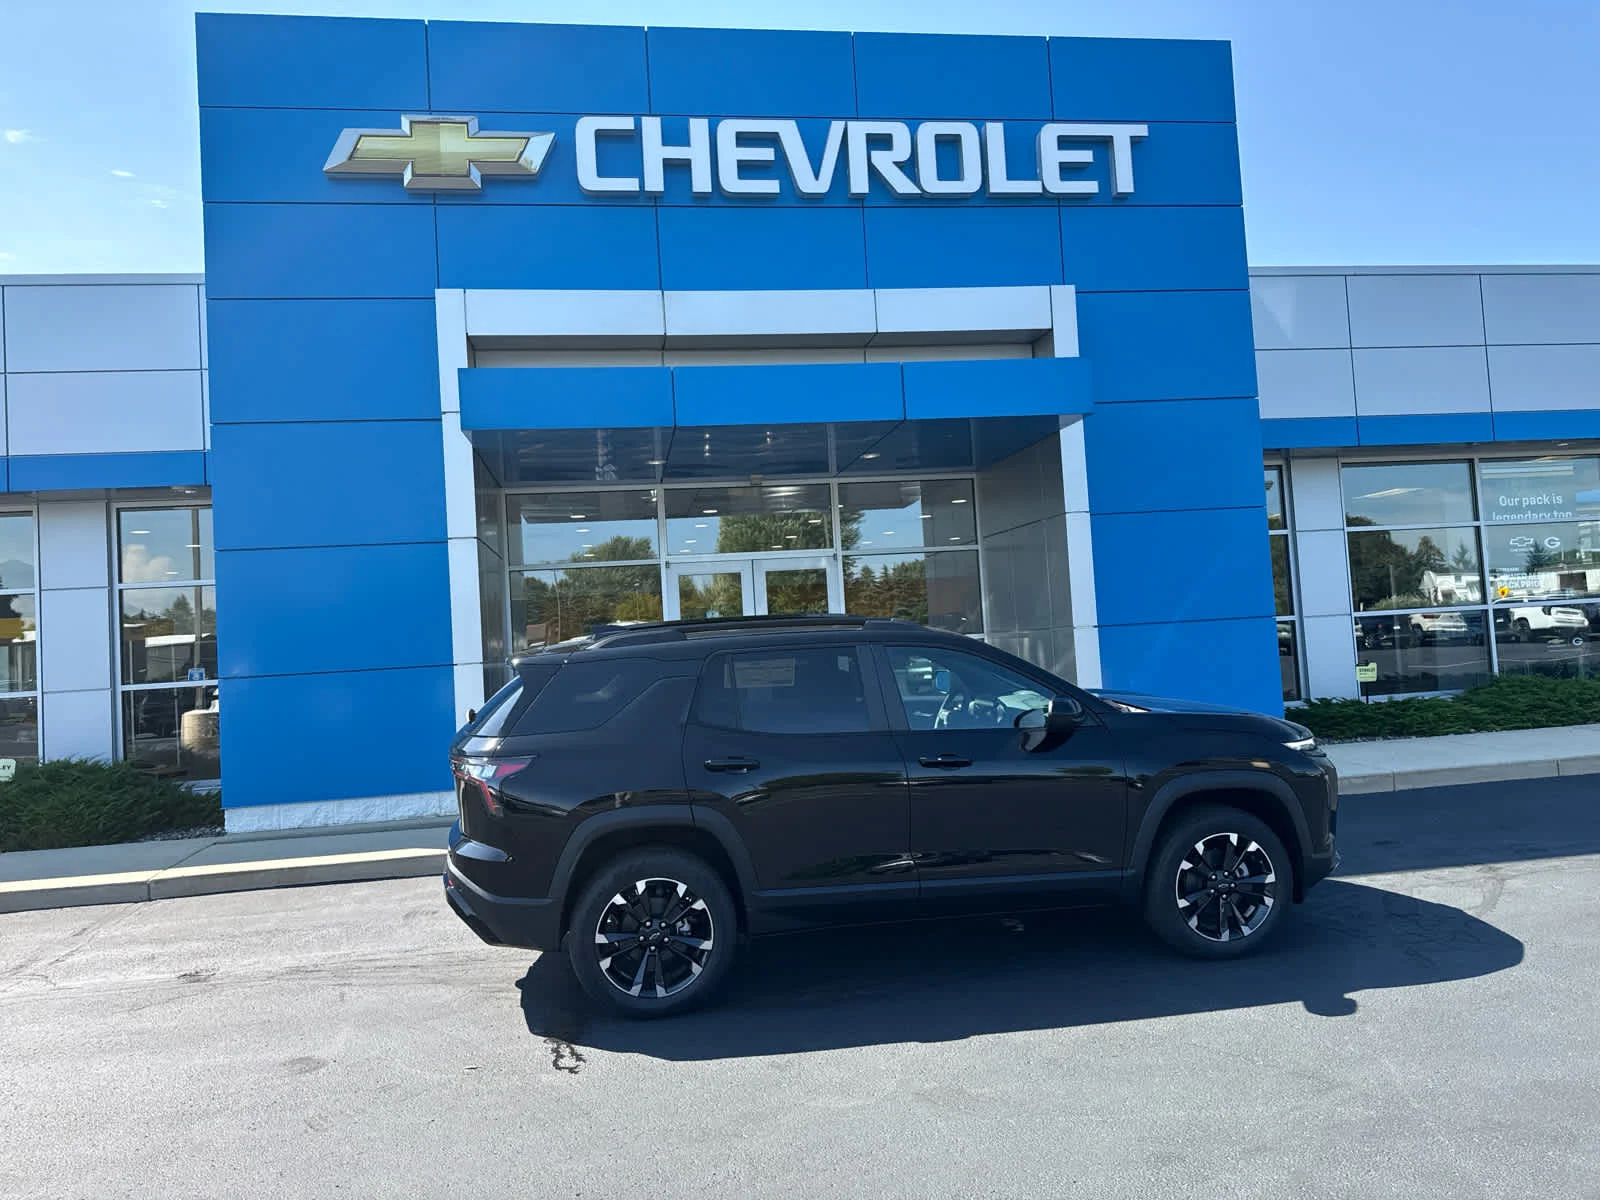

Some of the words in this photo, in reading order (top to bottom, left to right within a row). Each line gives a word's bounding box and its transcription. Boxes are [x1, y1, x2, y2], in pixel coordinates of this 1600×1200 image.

[575, 116, 1149, 197] CHEVROLET
[1499, 495, 1520, 506] Our
[1522, 493, 1550, 507] pack
[1552, 493, 1563, 504] is
